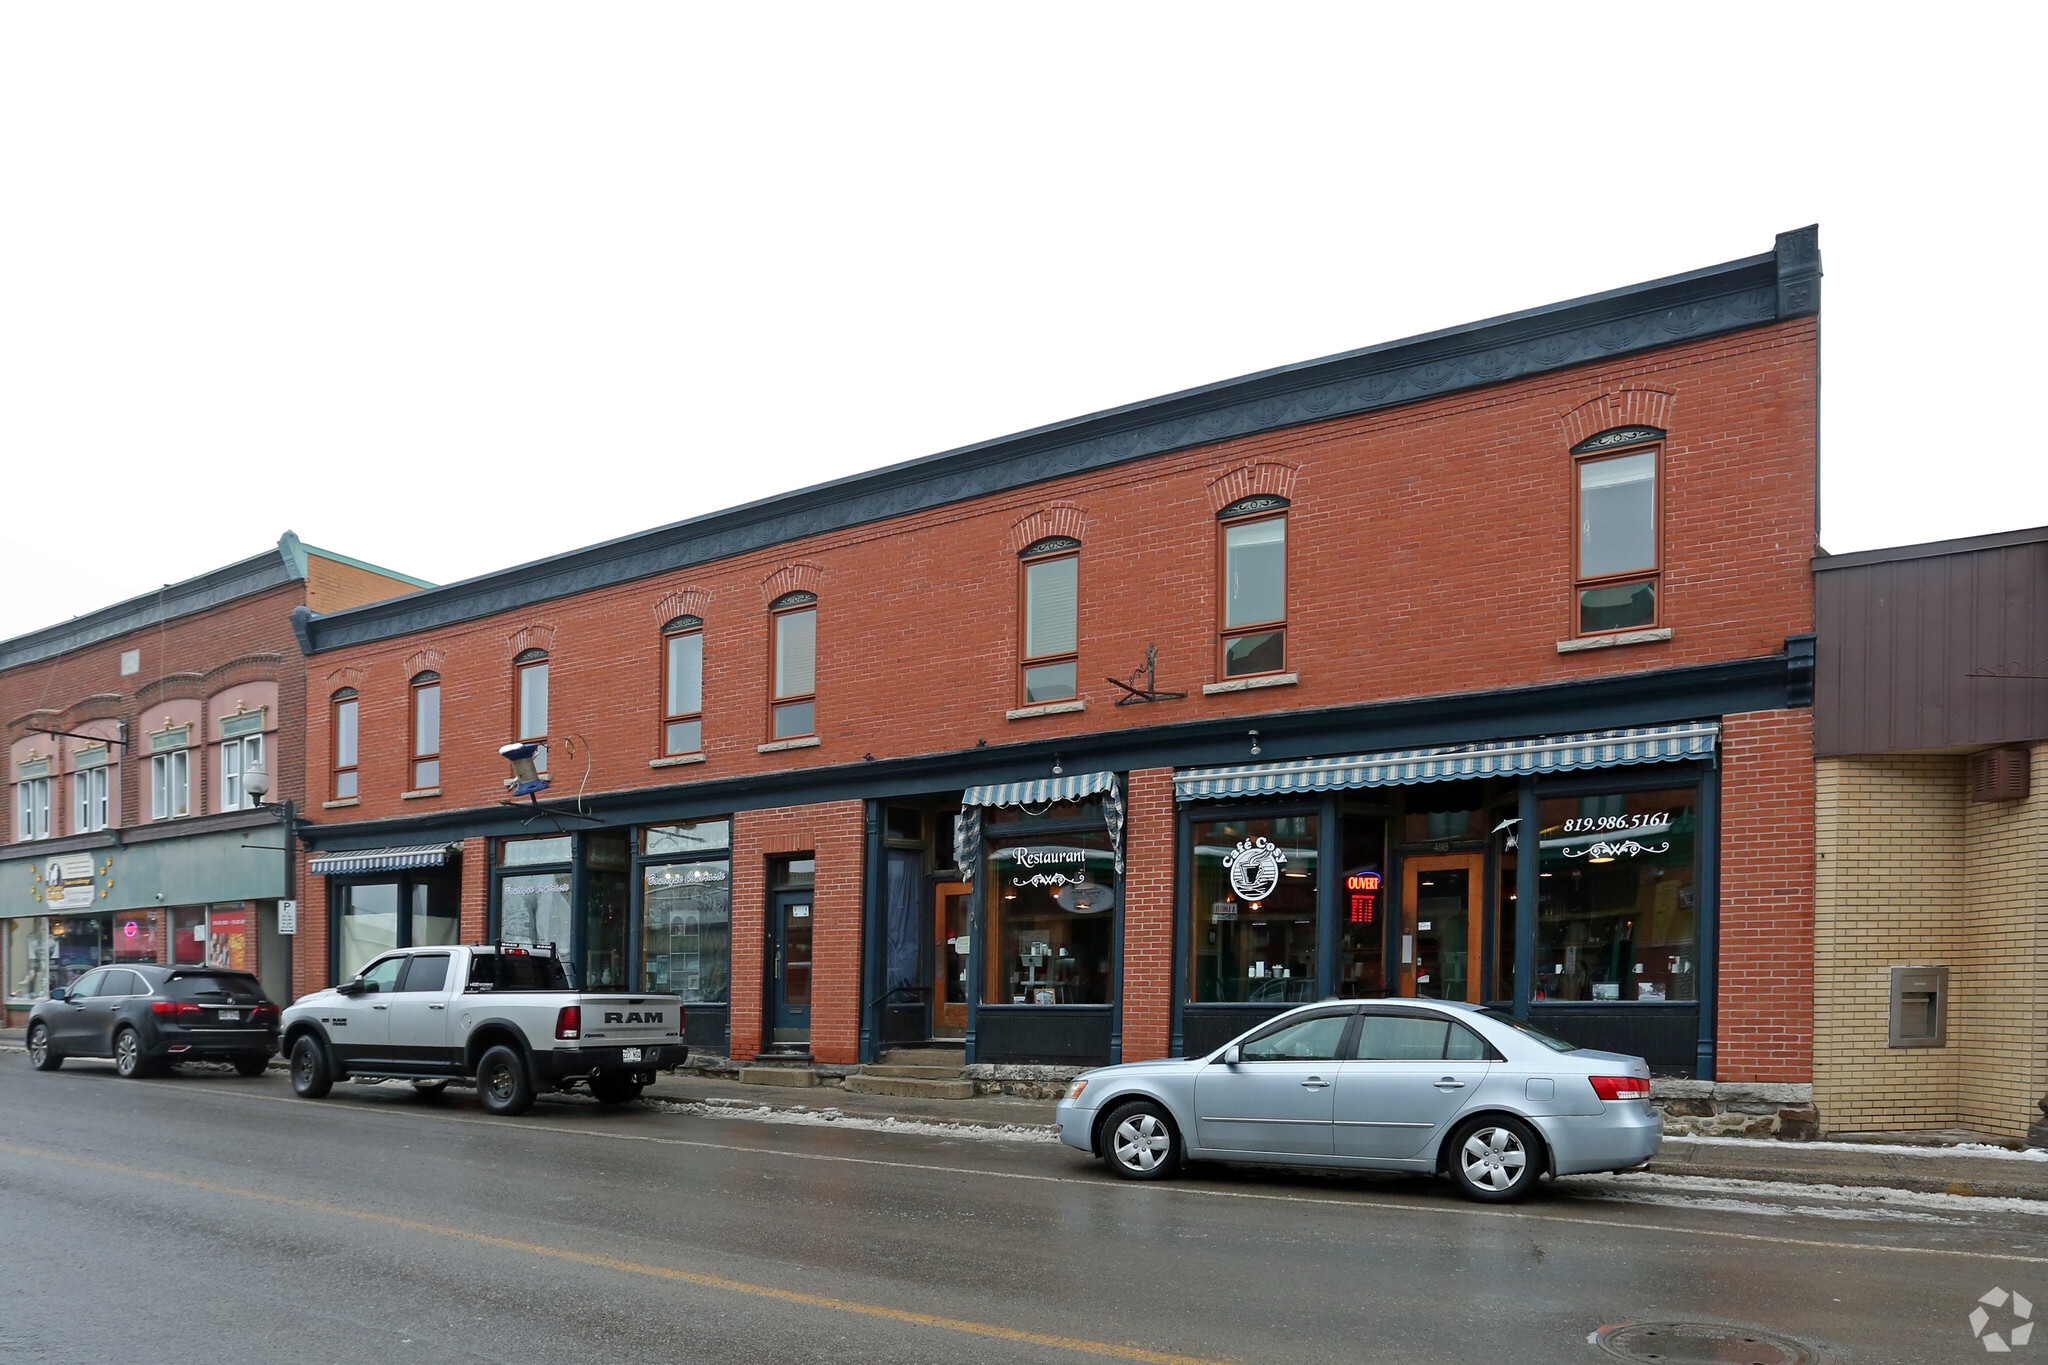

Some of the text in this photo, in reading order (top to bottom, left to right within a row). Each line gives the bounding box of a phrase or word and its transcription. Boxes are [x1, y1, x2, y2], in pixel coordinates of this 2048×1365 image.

[1563, 812, 1669, 832] 819.986.5161
[1222, 836, 1288, 868] Café Cosy
[1433, 842, 1449, 852] 498
[1012, 847, 1086, 868] Restaurant
[648, 873, 683, 887] Boutique
[1348, 876, 1379, 890] OUVERT
[283, 902, 291, 911] P
[604, 1012, 664, 1024] RAM
